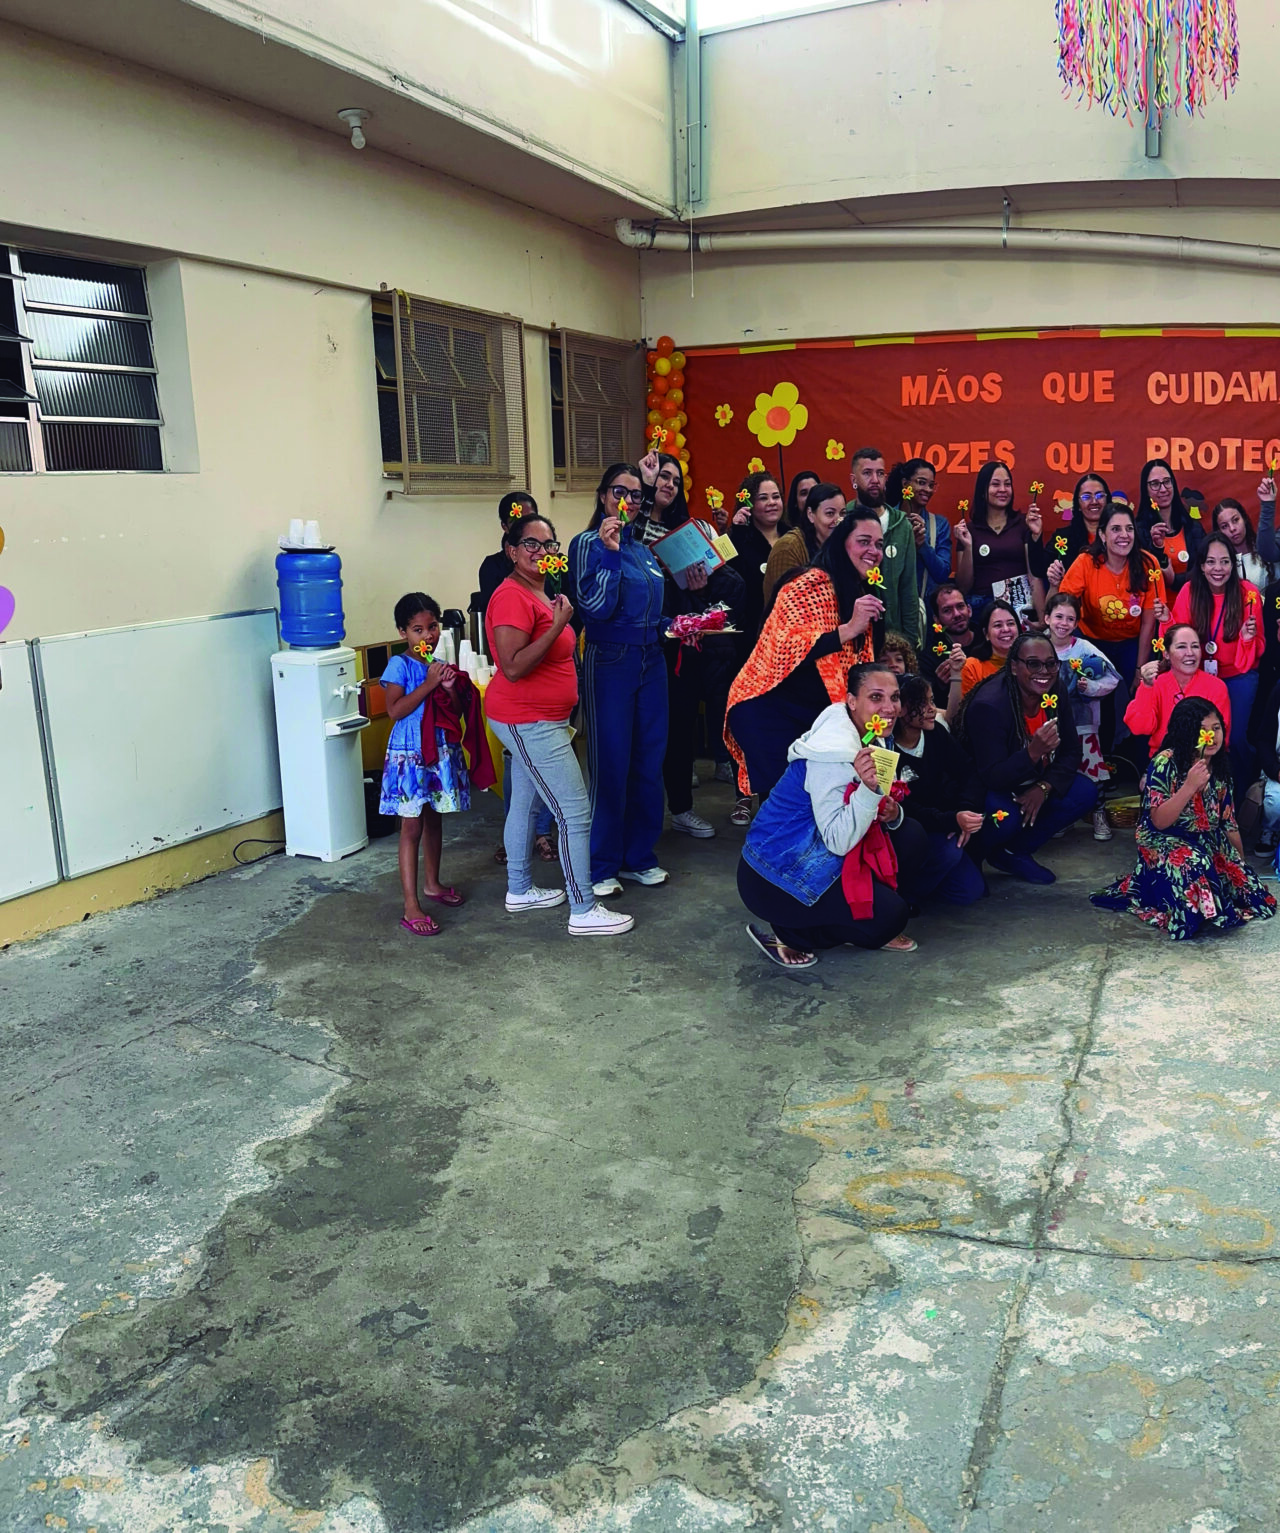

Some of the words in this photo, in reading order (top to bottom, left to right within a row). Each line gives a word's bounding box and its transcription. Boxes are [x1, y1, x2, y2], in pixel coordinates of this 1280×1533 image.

[902, 368, 1003, 406] MÃOS
[1043, 370, 1115, 404] QUE
[902, 440, 1015, 474] VOZES
[1045, 440, 1114, 474] QUE
